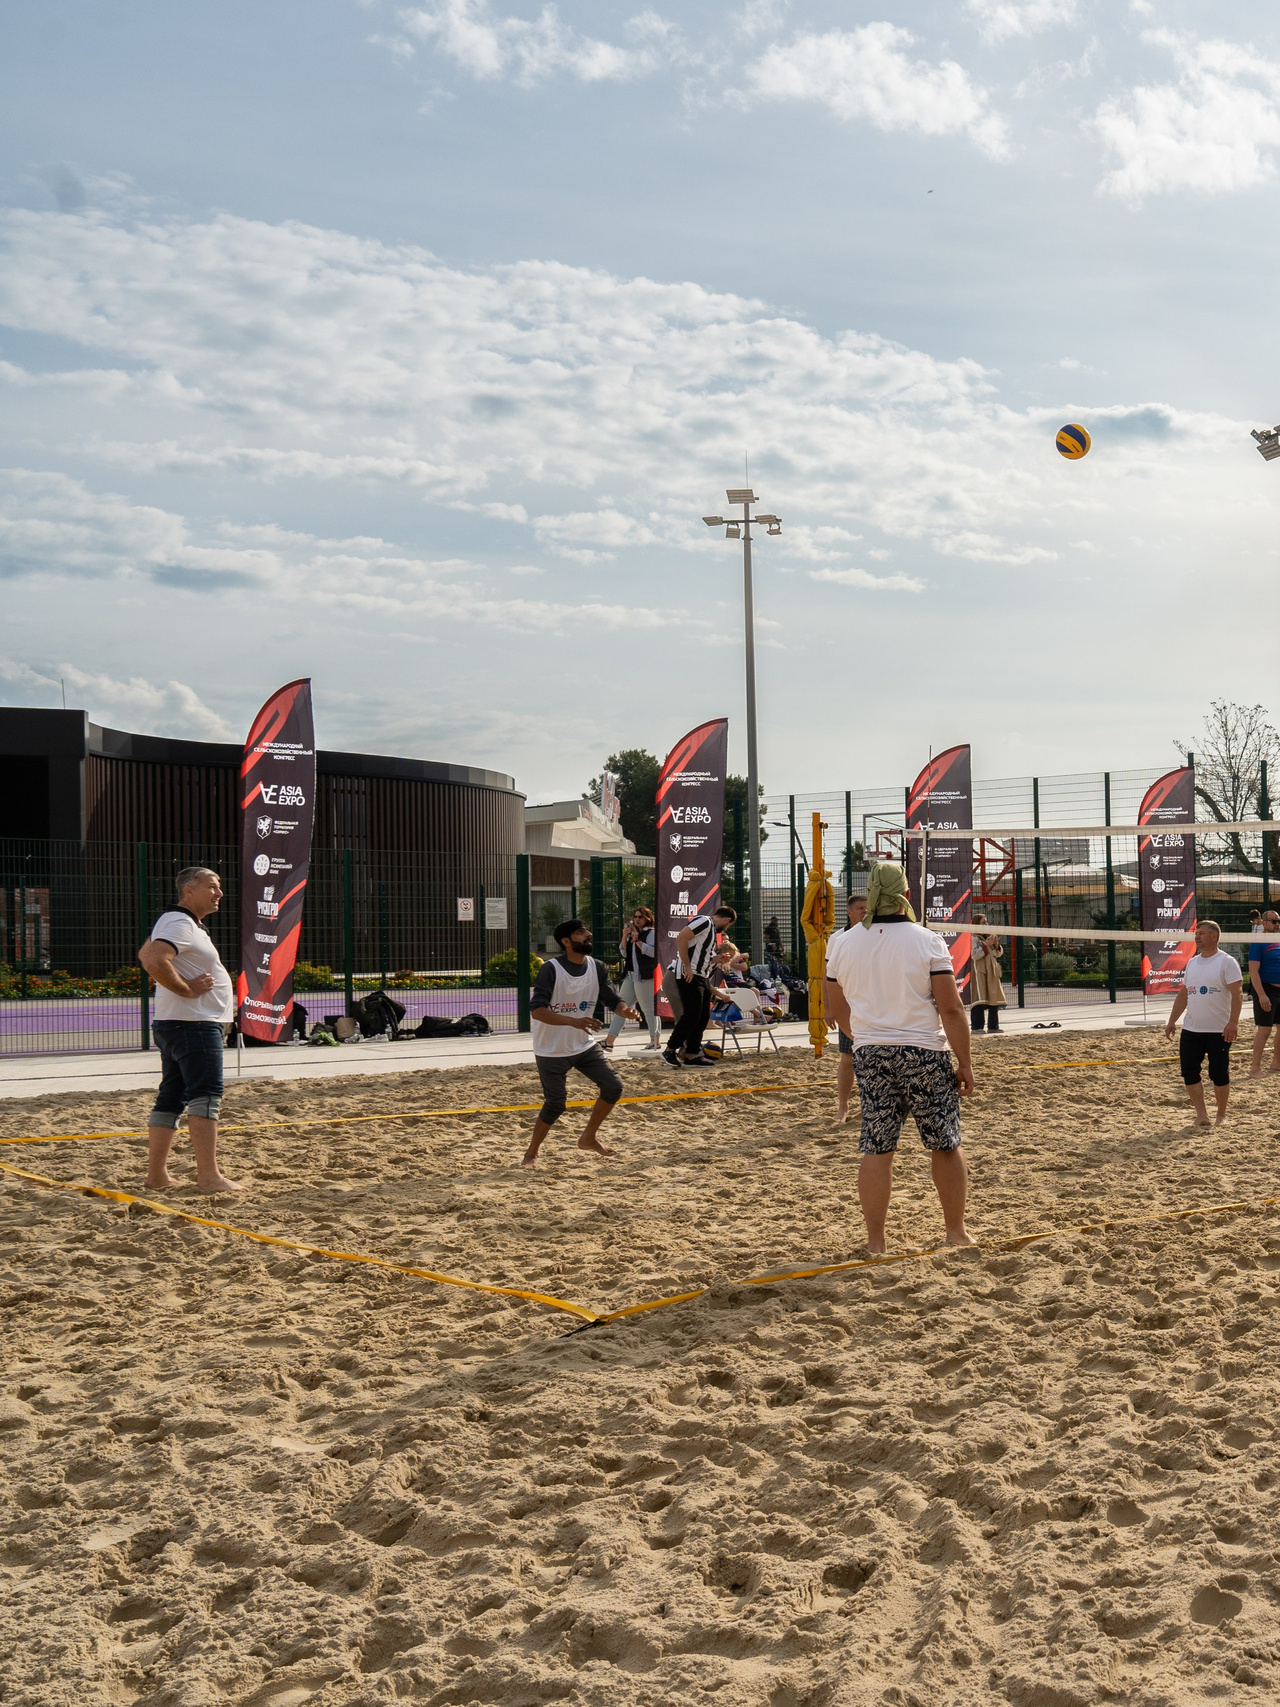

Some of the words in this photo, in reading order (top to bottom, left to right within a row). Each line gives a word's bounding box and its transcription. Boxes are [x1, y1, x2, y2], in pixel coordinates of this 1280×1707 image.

[279, 785, 303, 796] ASIA
[278, 795, 306, 806] EXPO
[685, 806, 709, 815] ASIA
[684, 815, 712, 824] EXPO
[936, 821, 959, 830] ASIA
[670, 904, 698, 916] РУСАГРО
